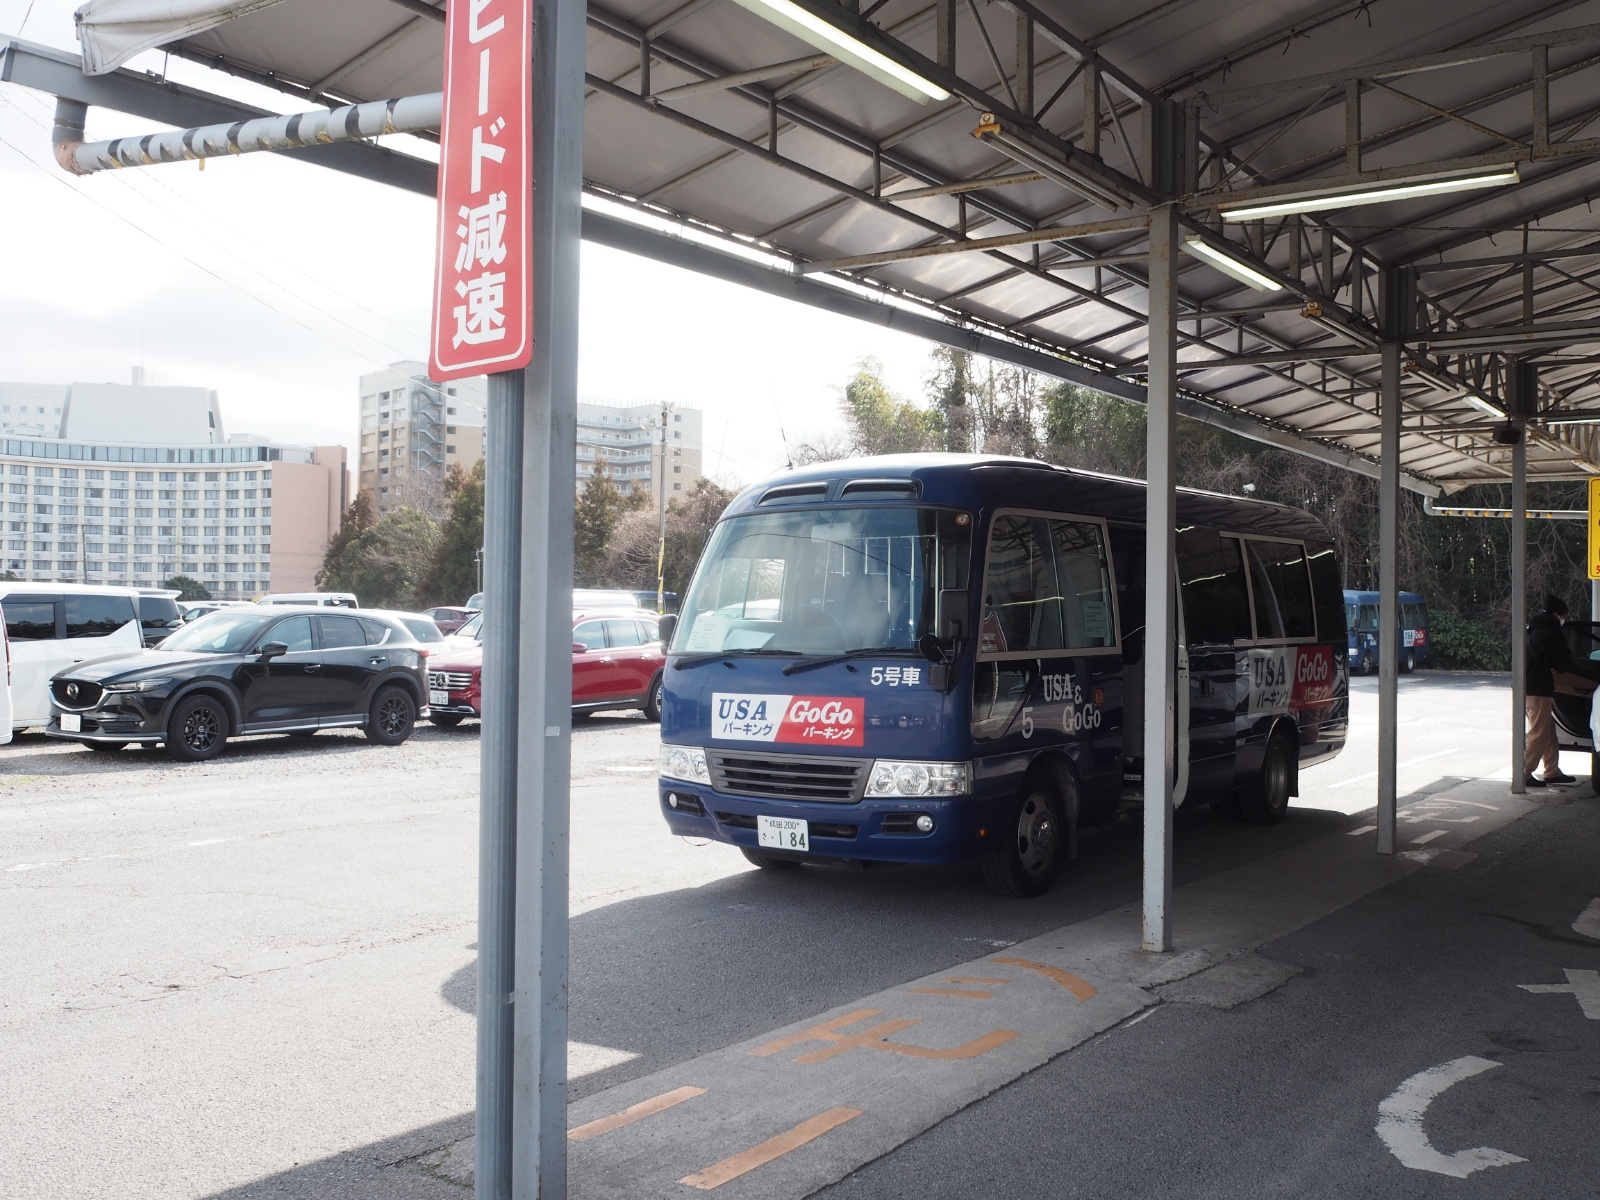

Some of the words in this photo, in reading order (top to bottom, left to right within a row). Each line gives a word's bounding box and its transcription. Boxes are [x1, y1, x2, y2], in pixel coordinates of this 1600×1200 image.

[870, 666, 921, 687] 5号車
[1254, 655, 1286, 688] USA
[1297, 652, 1328, 683] GoGo
[1256, 687, 1290, 708] パーキング
[718, 698, 768, 721] USA
[789, 700, 854, 725] GoGo
[1062, 702, 1101, 732] GoGo
[723, 722, 774, 736] パーキング
[803, 726, 856, 740] パーキング
[1021, 706, 1034, 739] 5
[783, 821, 797, 830] 200
